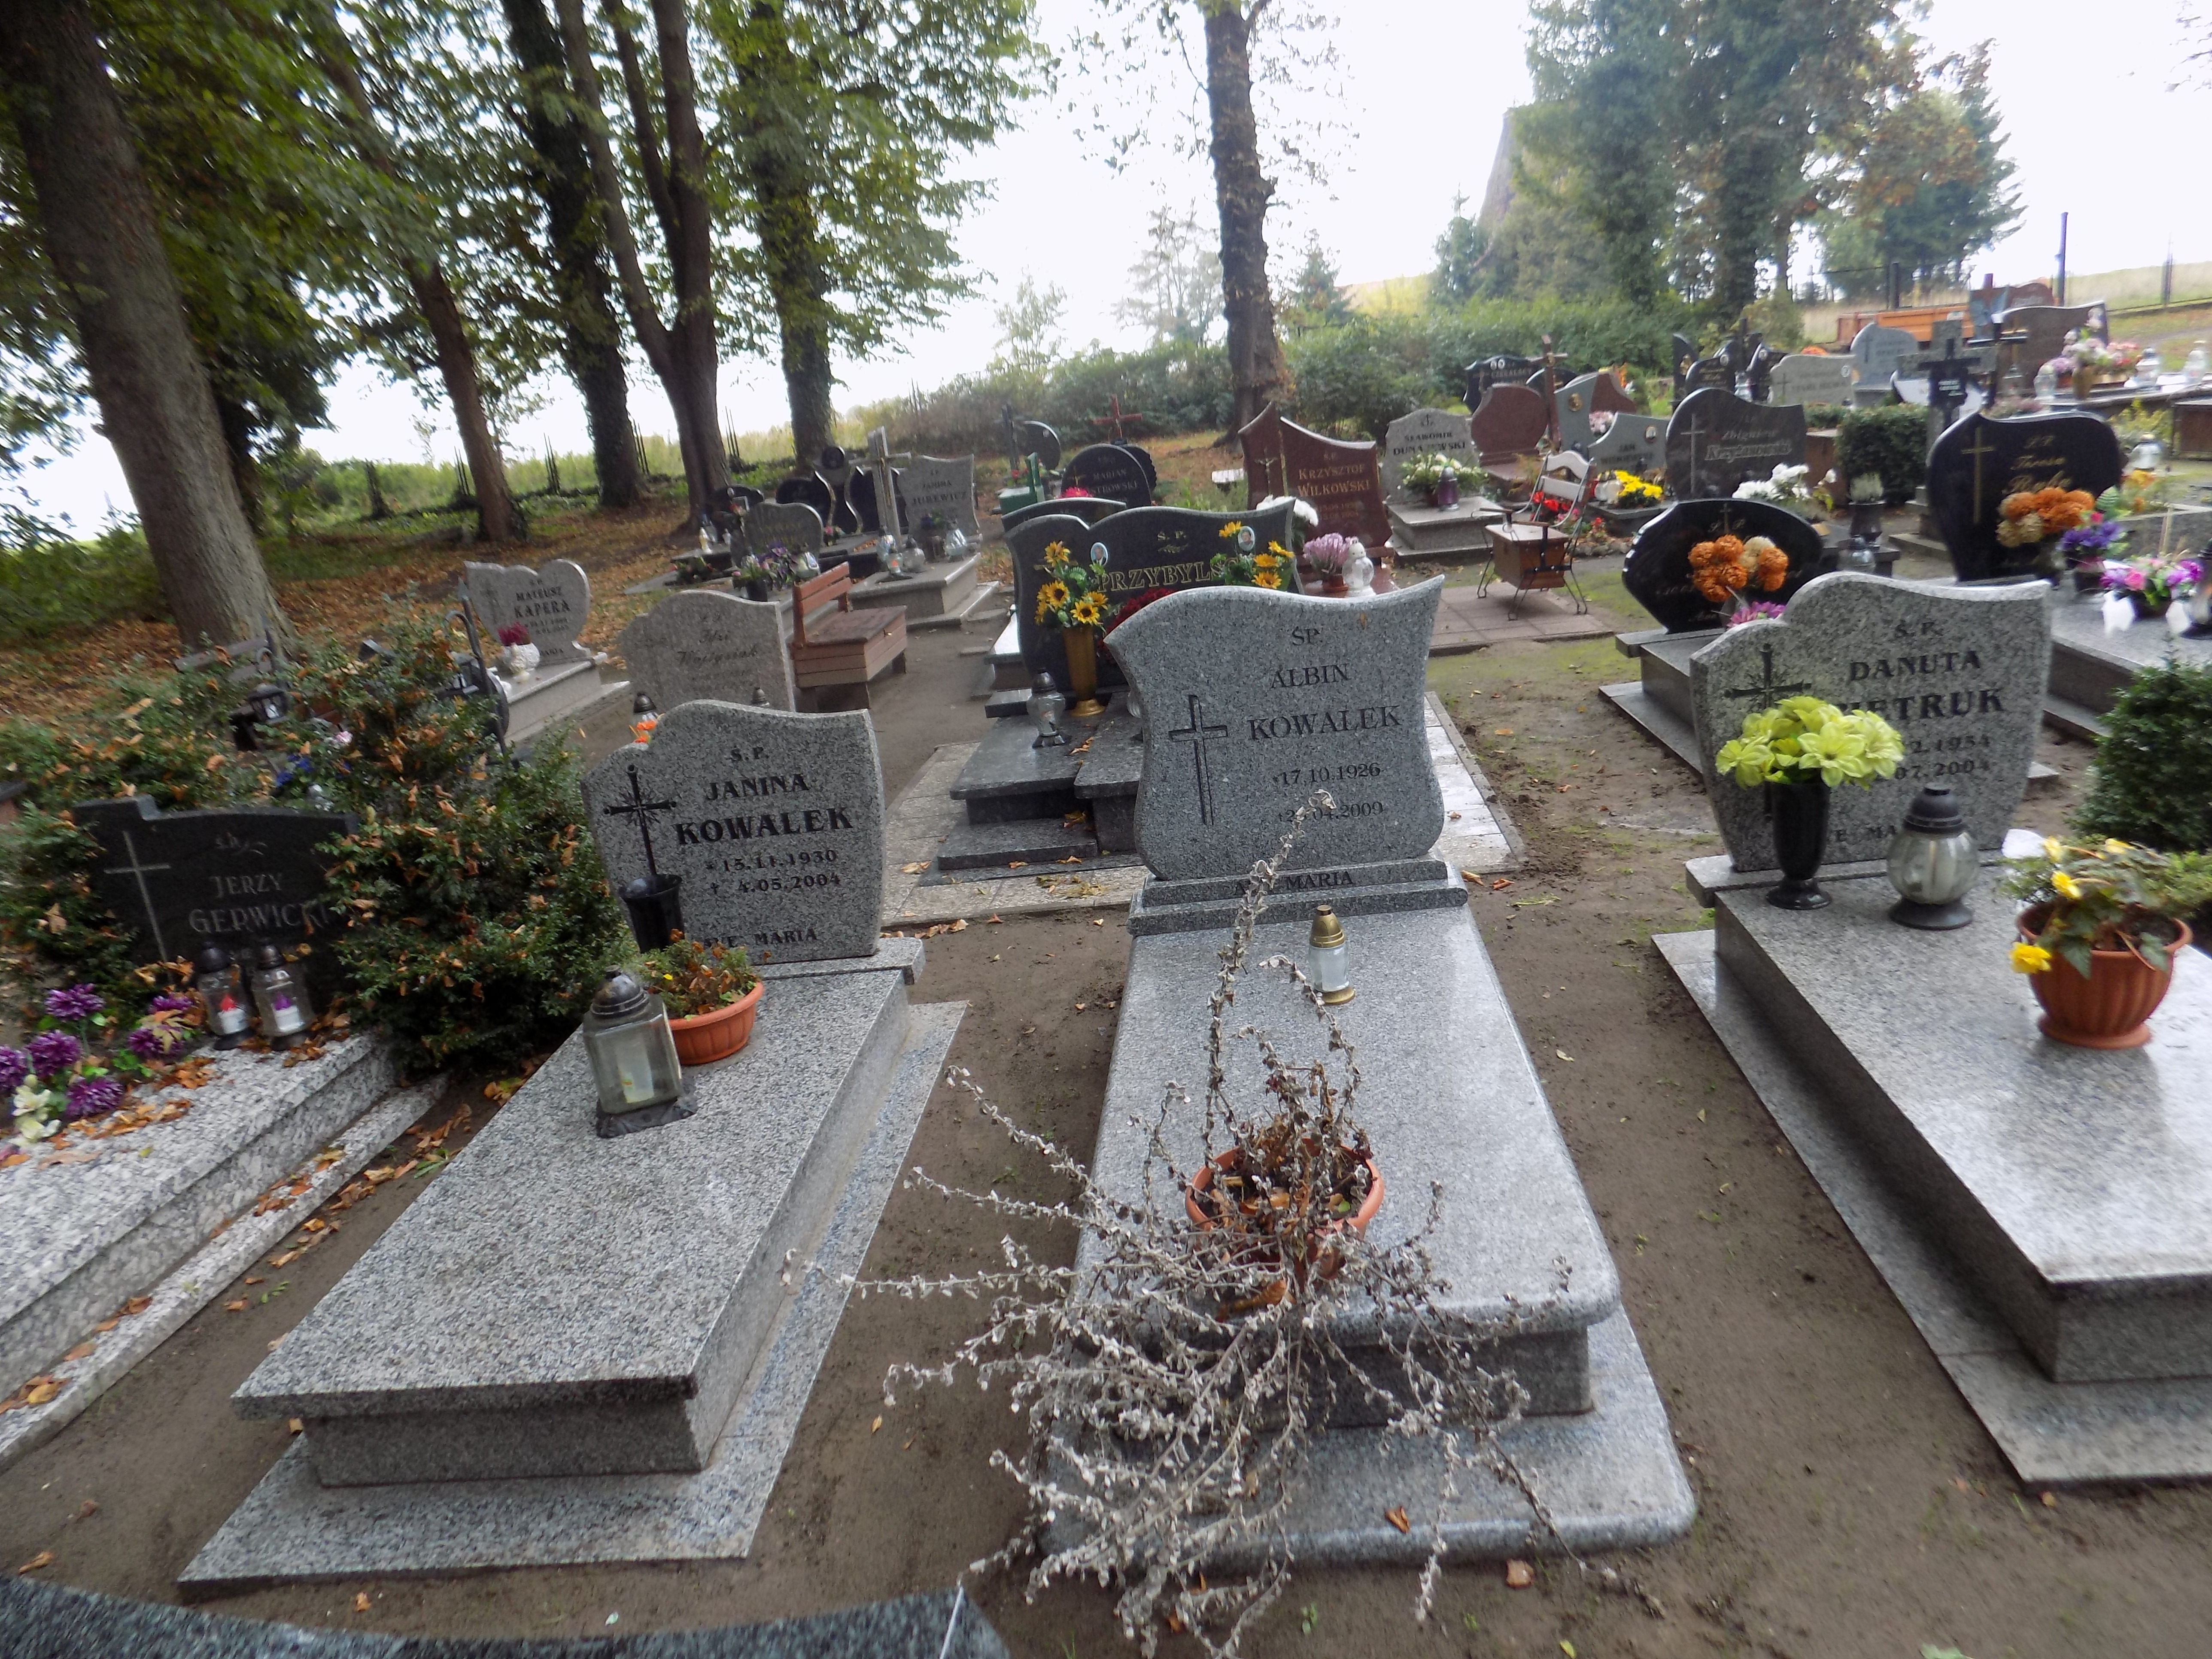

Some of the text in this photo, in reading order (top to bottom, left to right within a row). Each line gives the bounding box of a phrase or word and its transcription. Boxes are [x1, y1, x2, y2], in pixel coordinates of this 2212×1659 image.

[1298, 464, 1365, 480] KRZYSZTOF
[1297, 479, 1370, 497] WILKOWSKI
[1270, 663, 1352, 688] ALBIN
[1850, 650, 1981, 681] DANUTA
[1247, 705, 1403, 740] KOWALEK
[705, 773, 809, 801] JANINA
[672, 807, 854, 845] KOWALEK
[1286, 870, 1354, 890] MARIA
[753, 927, 817, 946] MARIA
